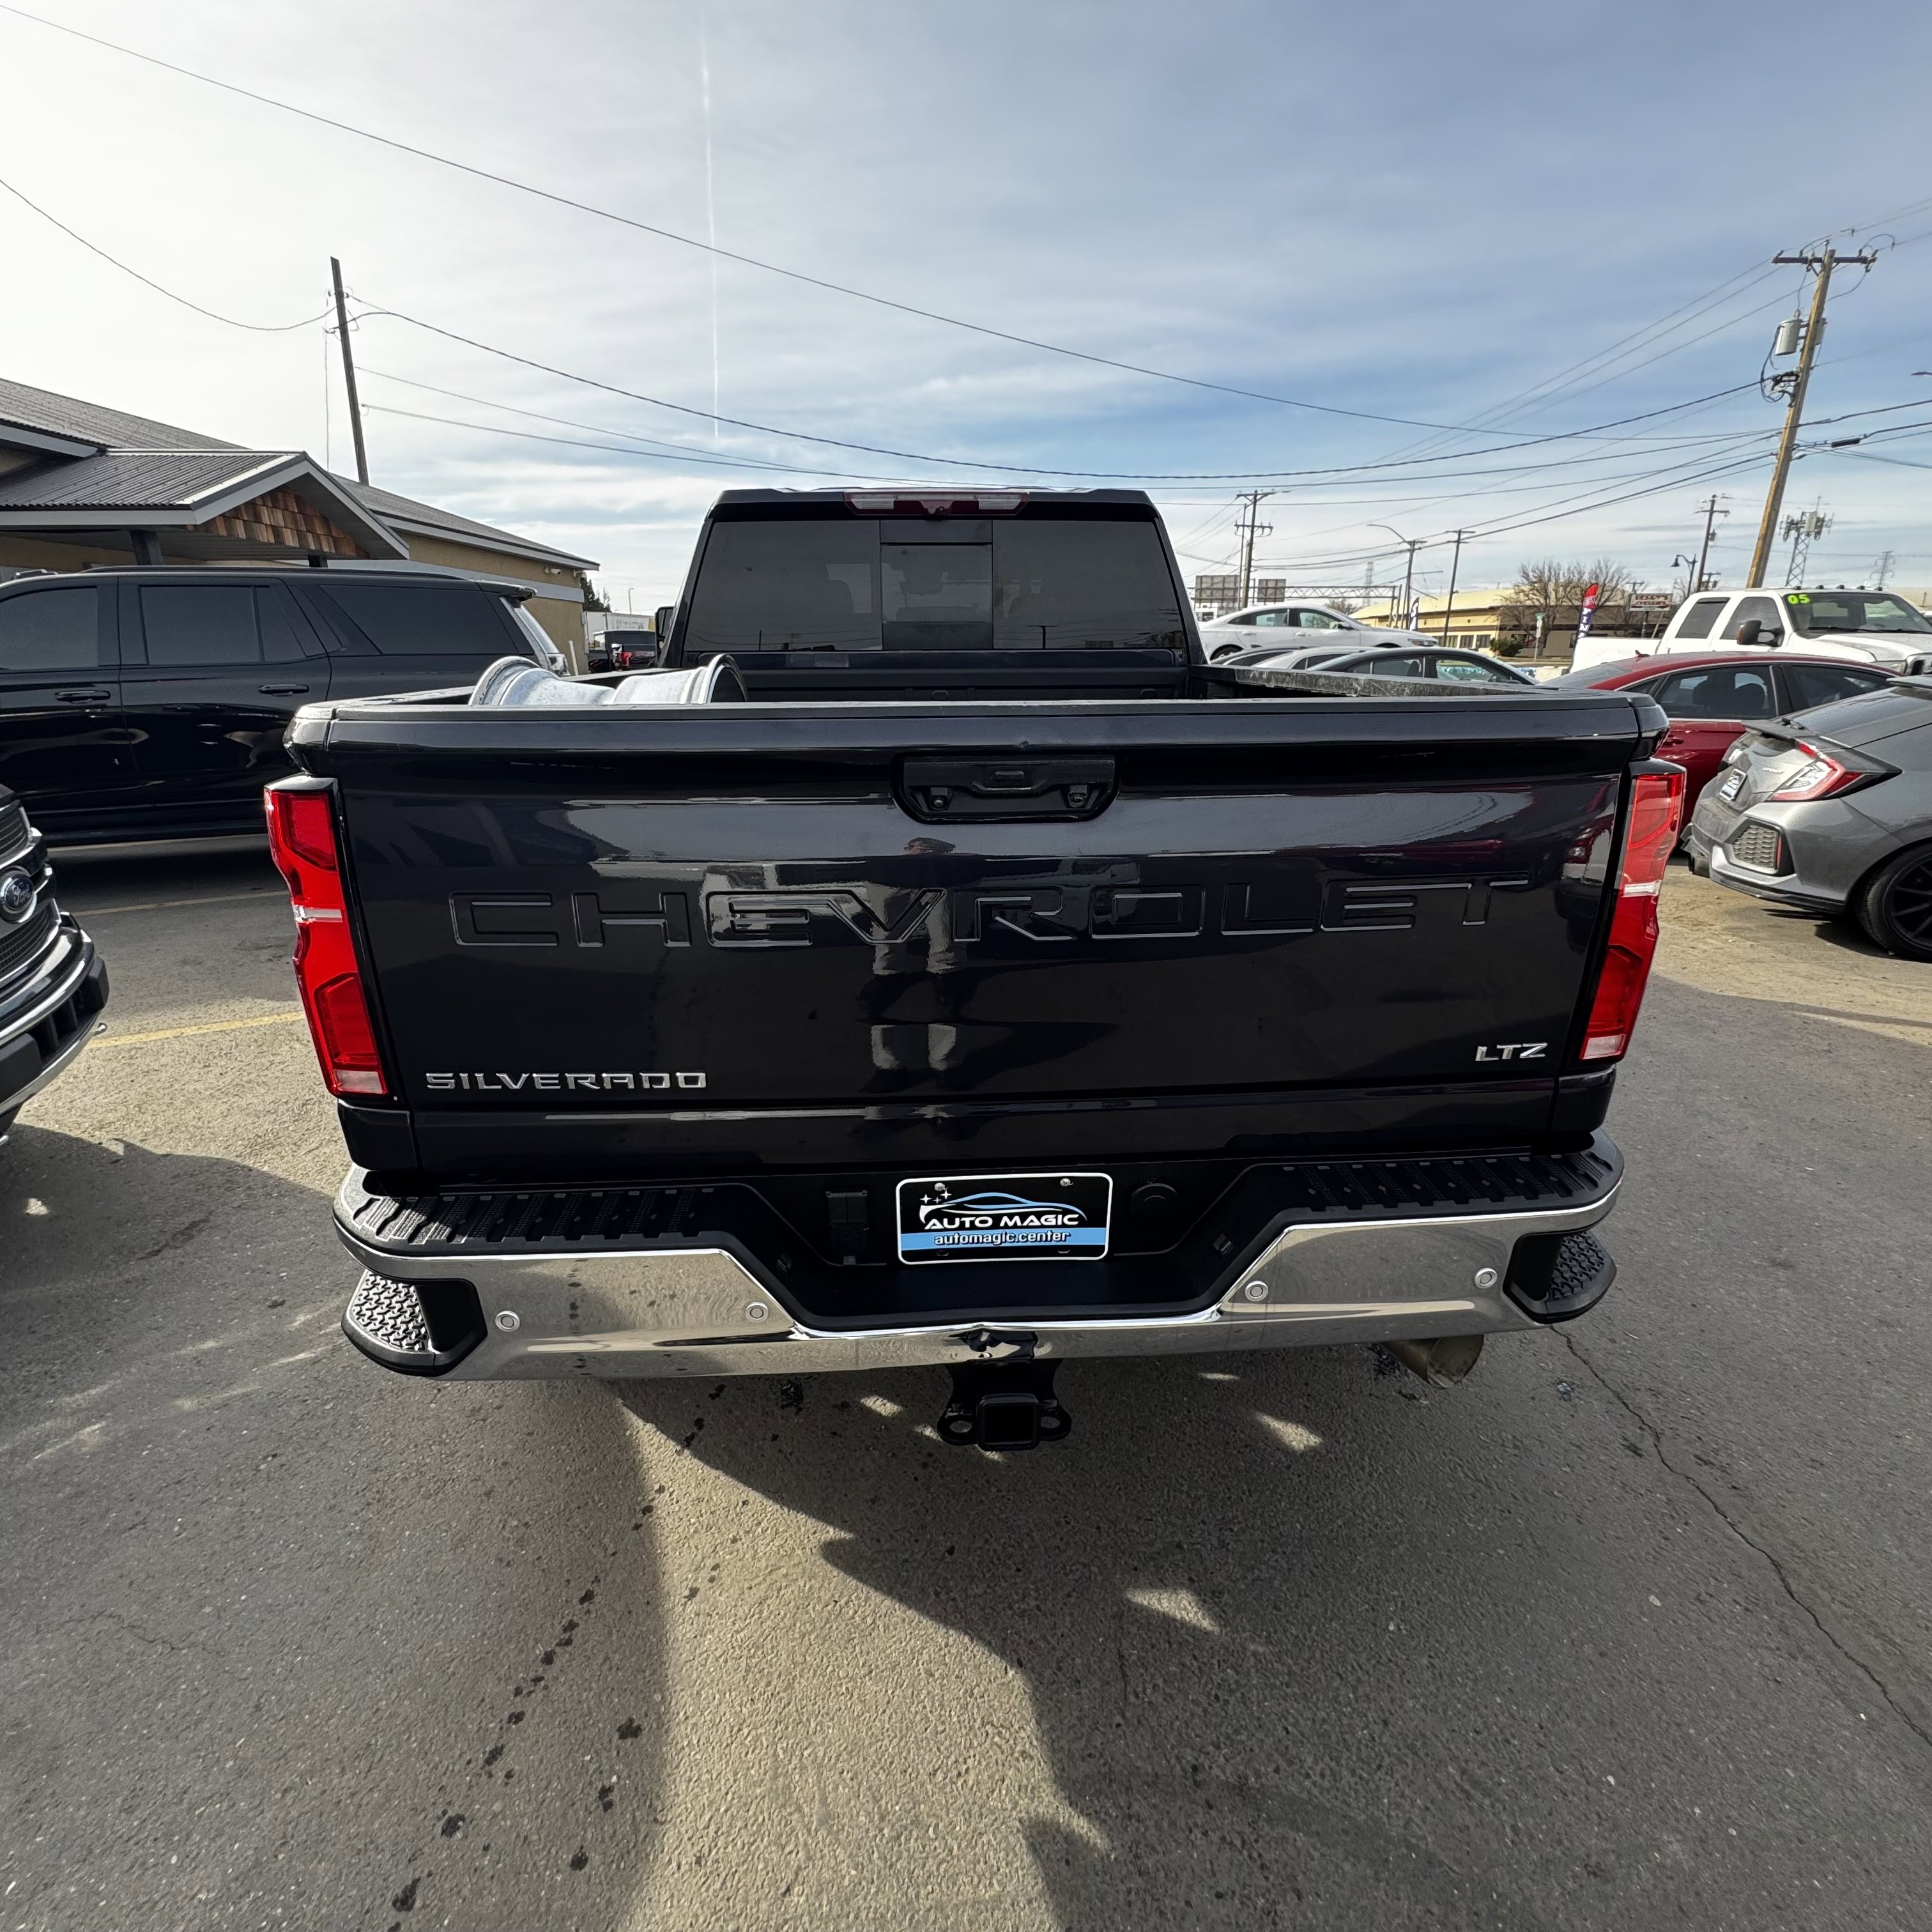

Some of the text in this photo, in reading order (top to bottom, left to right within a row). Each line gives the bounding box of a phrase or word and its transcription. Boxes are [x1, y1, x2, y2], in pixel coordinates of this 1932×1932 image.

[1788, 594, 1811, 604] 05
[448, 871, 1531, 947] CHEVROLET
[1475, 1042, 1548, 1062] LTZ
[426, 1072, 707, 1089] SILVERADO
[924, 1214, 1080, 1230] AUTO MAGIC
[934, 1230, 1071, 1246] automagic.center
